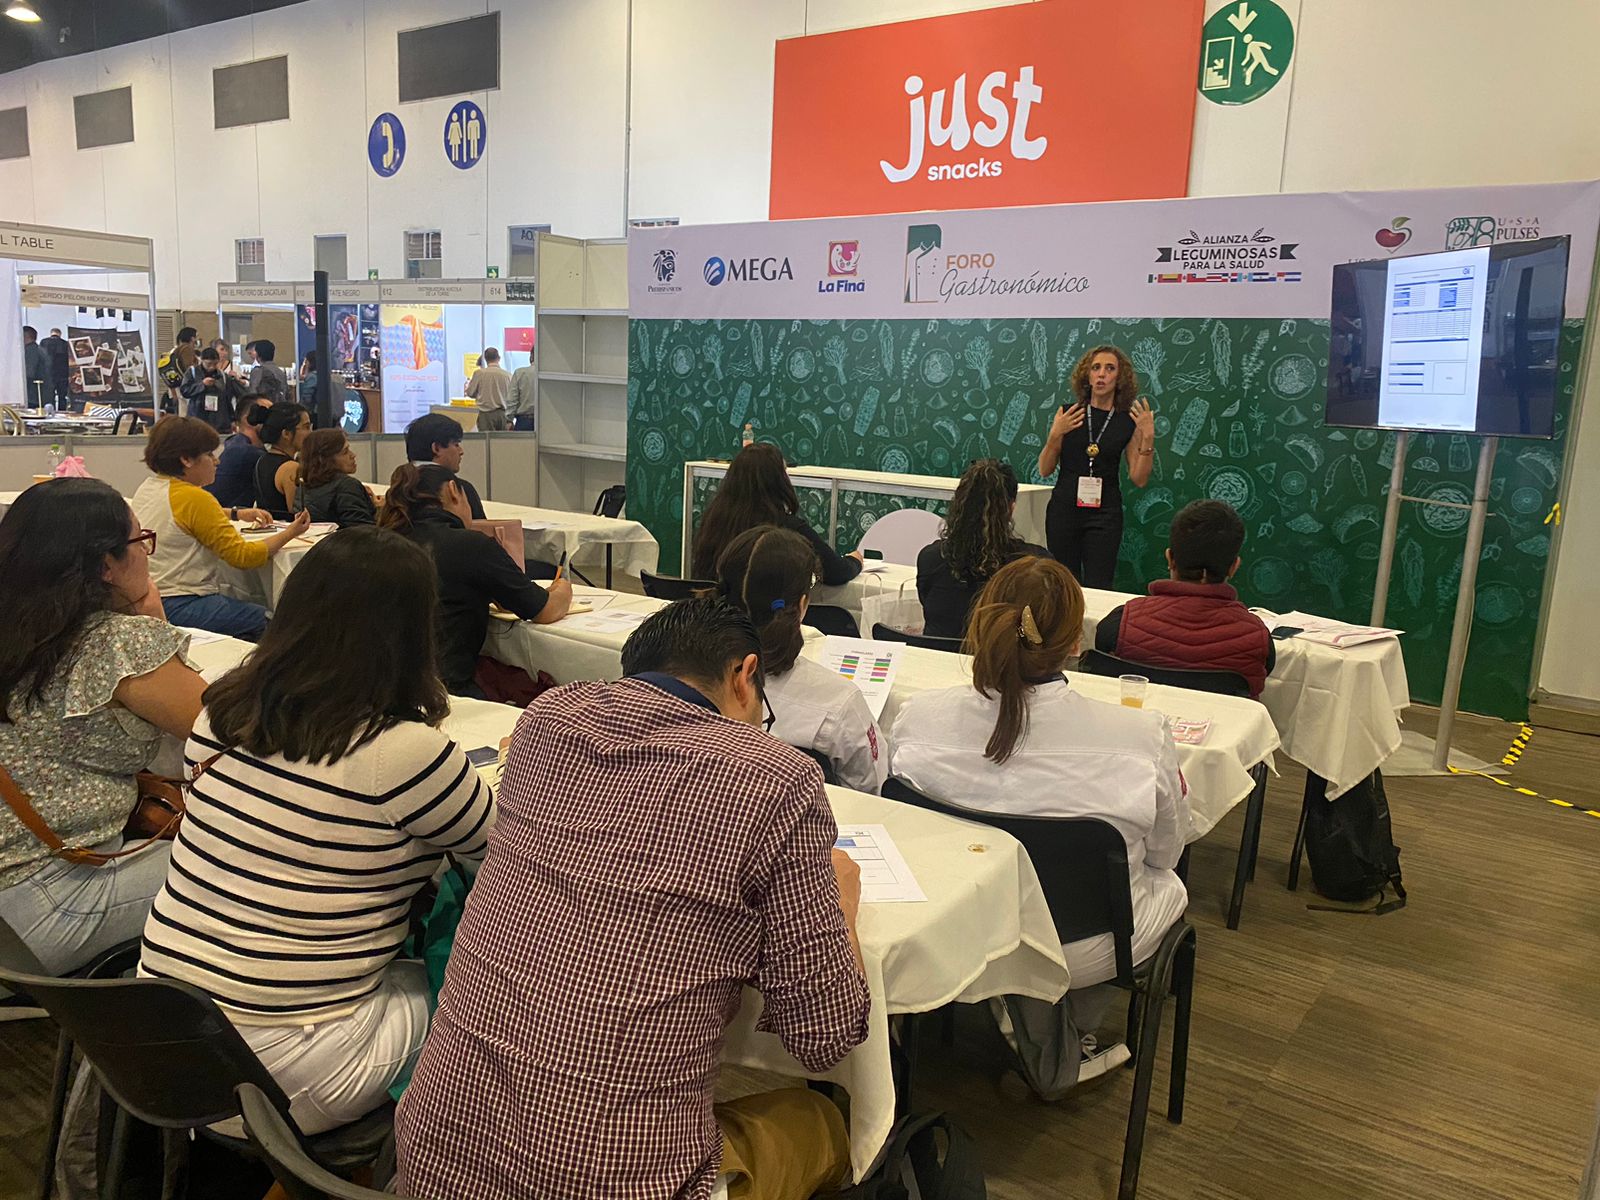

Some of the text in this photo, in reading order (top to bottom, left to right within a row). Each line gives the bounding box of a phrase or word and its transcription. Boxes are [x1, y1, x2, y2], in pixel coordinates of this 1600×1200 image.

[879, 65, 1048, 183] just
[927, 157, 1002, 181] snacks
[1203, 235, 1249, 245] ALIANZA
[1496, 226, 1540, 240] PULSES
[12, 235, 54, 250] TABLE
[946, 252, 995, 270] FORO
[1173, 247, 1278, 262] LEGUMINOSAS
[727, 257, 794, 282] MEGA
[1183, 260, 1265, 271] PARA LA SALUD
[382, 288, 392, 296] 612
[818, 279, 866, 293] La Fina
[940, 268, 1090, 304] Gastronómico
